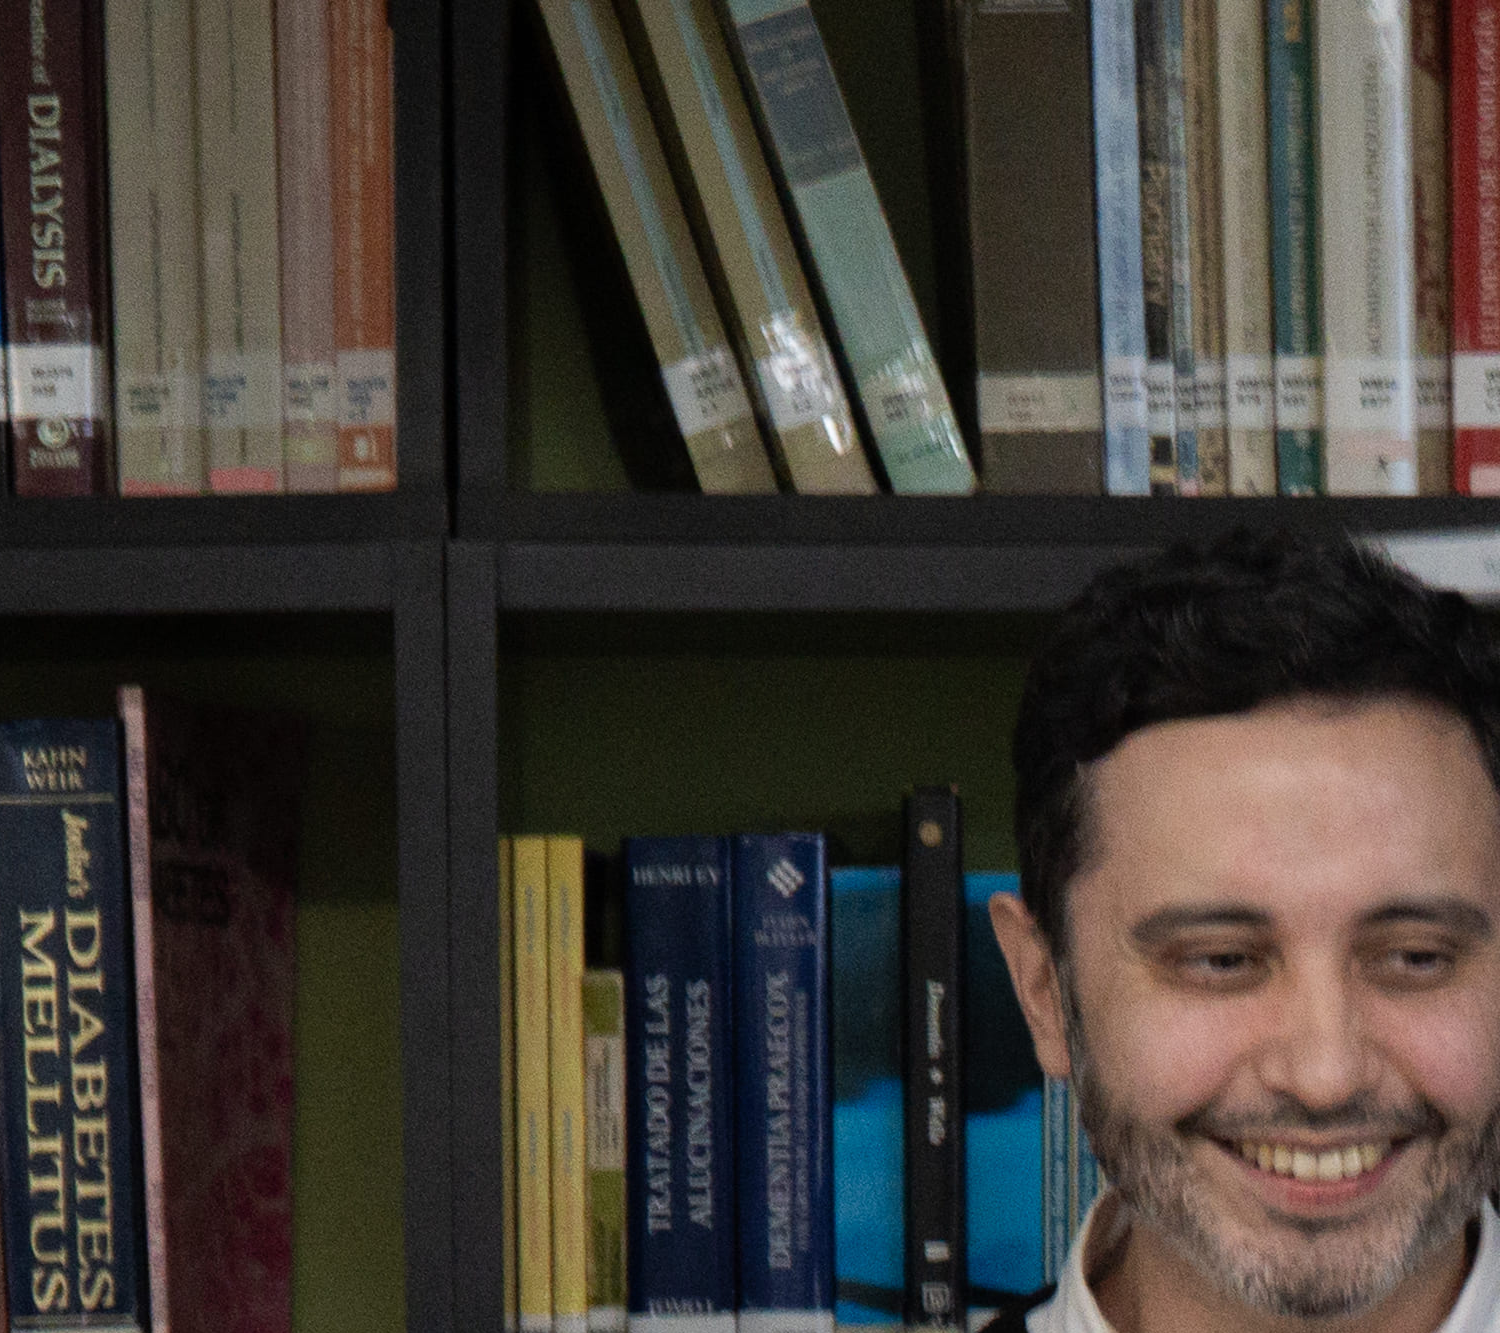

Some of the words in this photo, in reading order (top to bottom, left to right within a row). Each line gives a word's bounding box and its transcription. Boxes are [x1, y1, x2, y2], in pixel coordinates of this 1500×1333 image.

[26, 92, 69, 290] DIALYSIS
[21, 745, 89, 768] KAHN
[24, 769, 85, 791] WEIR
[632, 866, 690, 886] HENRI
[643, 974, 671, 1037] LAS
[643, 1039, 671, 1085] DE
[764, 971, 792, 1112] PRAECOX
[19, 909, 70, 1312] MELLITUS
[65, 906, 117, 1311] DIABETES
[644, 1086, 673, 1237] TRATADO
[686, 979, 714, 1230] ALUCINACIONES
[765, 1112, 793, 1270] DEMENTIA
